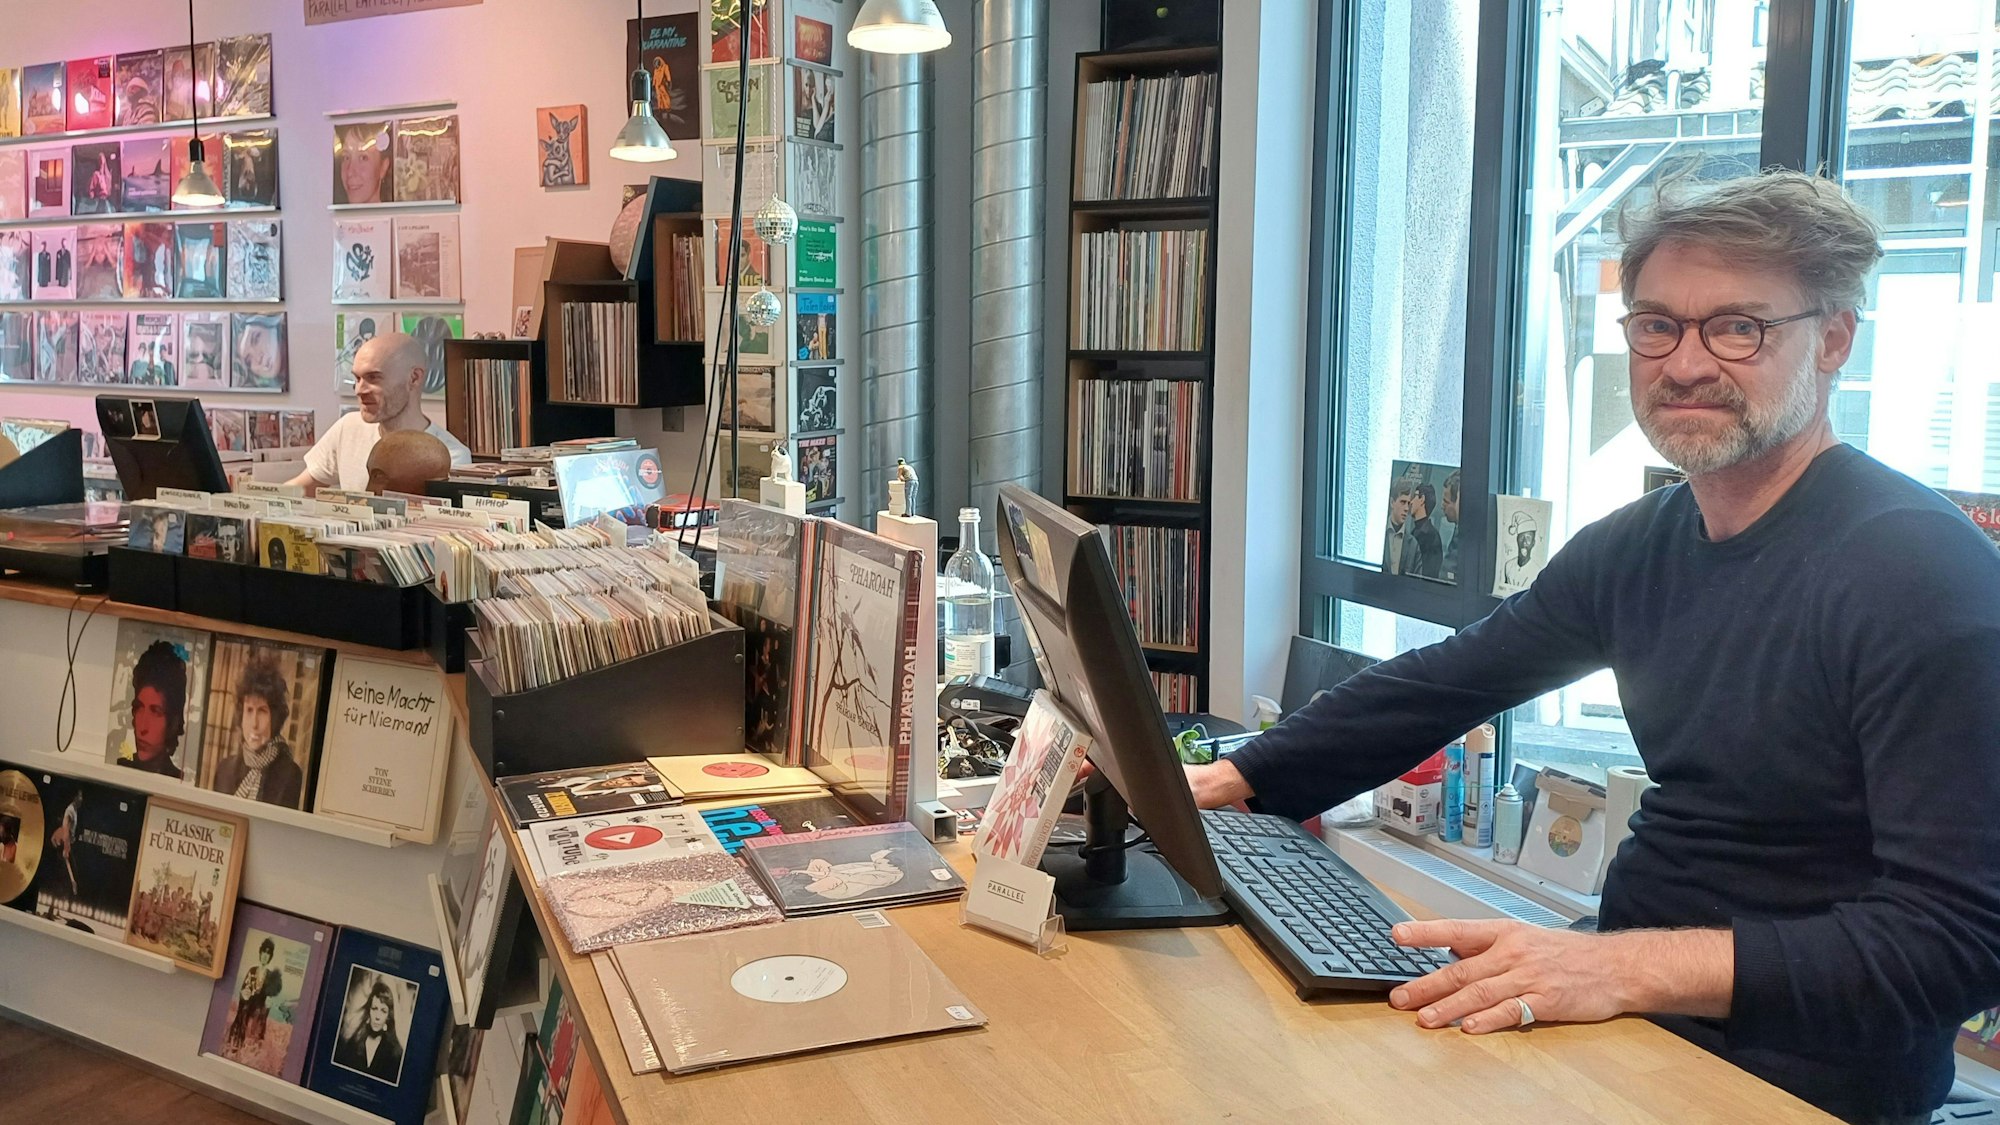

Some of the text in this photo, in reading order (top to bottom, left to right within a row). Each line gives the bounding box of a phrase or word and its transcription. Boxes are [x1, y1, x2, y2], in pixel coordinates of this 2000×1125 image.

[649, 28, 661, 39] BE
[332, 504, 351, 515] JAZZ
[475, 498, 509, 509] HIPHOP
[850, 562, 895, 600] PHAROAH
[347, 679, 436, 713] Keine Macht
[898, 645, 917, 746] PHAROAH
[344, 707, 432, 737] für Niemand
[367, 776, 393, 787] STEINE
[374, 767, 389, 778] TON
[361, 784, 397, 797] SCHERBEN
[165, 818, 215, 844] KLASSIK
[149, 830, 174, 853] FÜR
[177, 839, 225, 866] KINDER
[987, 882, 1025, 902] PARALLEL
